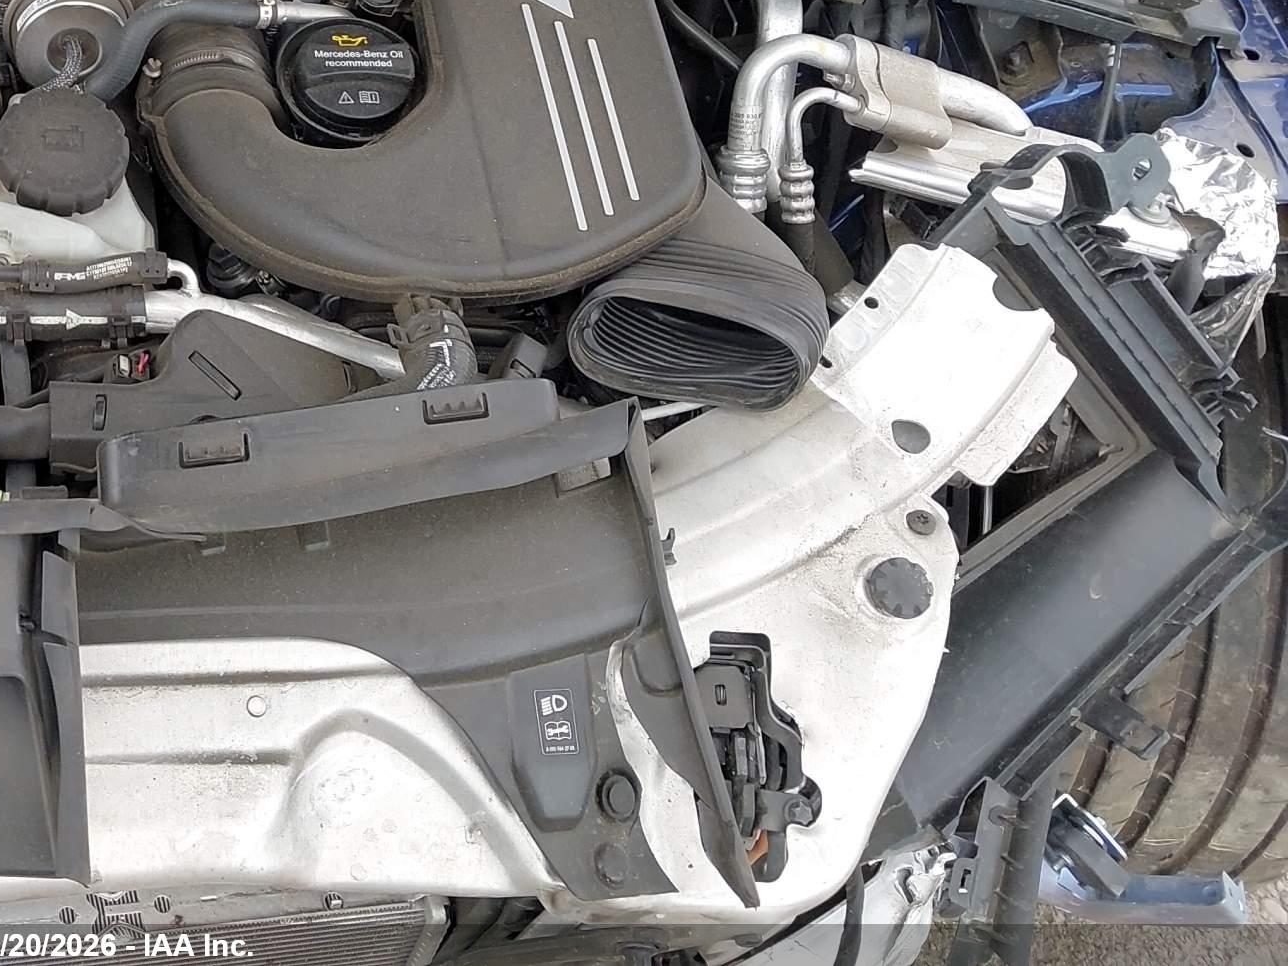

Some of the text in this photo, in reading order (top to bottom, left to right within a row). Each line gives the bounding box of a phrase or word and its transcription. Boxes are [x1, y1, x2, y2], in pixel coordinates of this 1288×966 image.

[314, 50, 404, 59] Mercedes-Benz Oil
[325, 60, 393, 68] recommended
